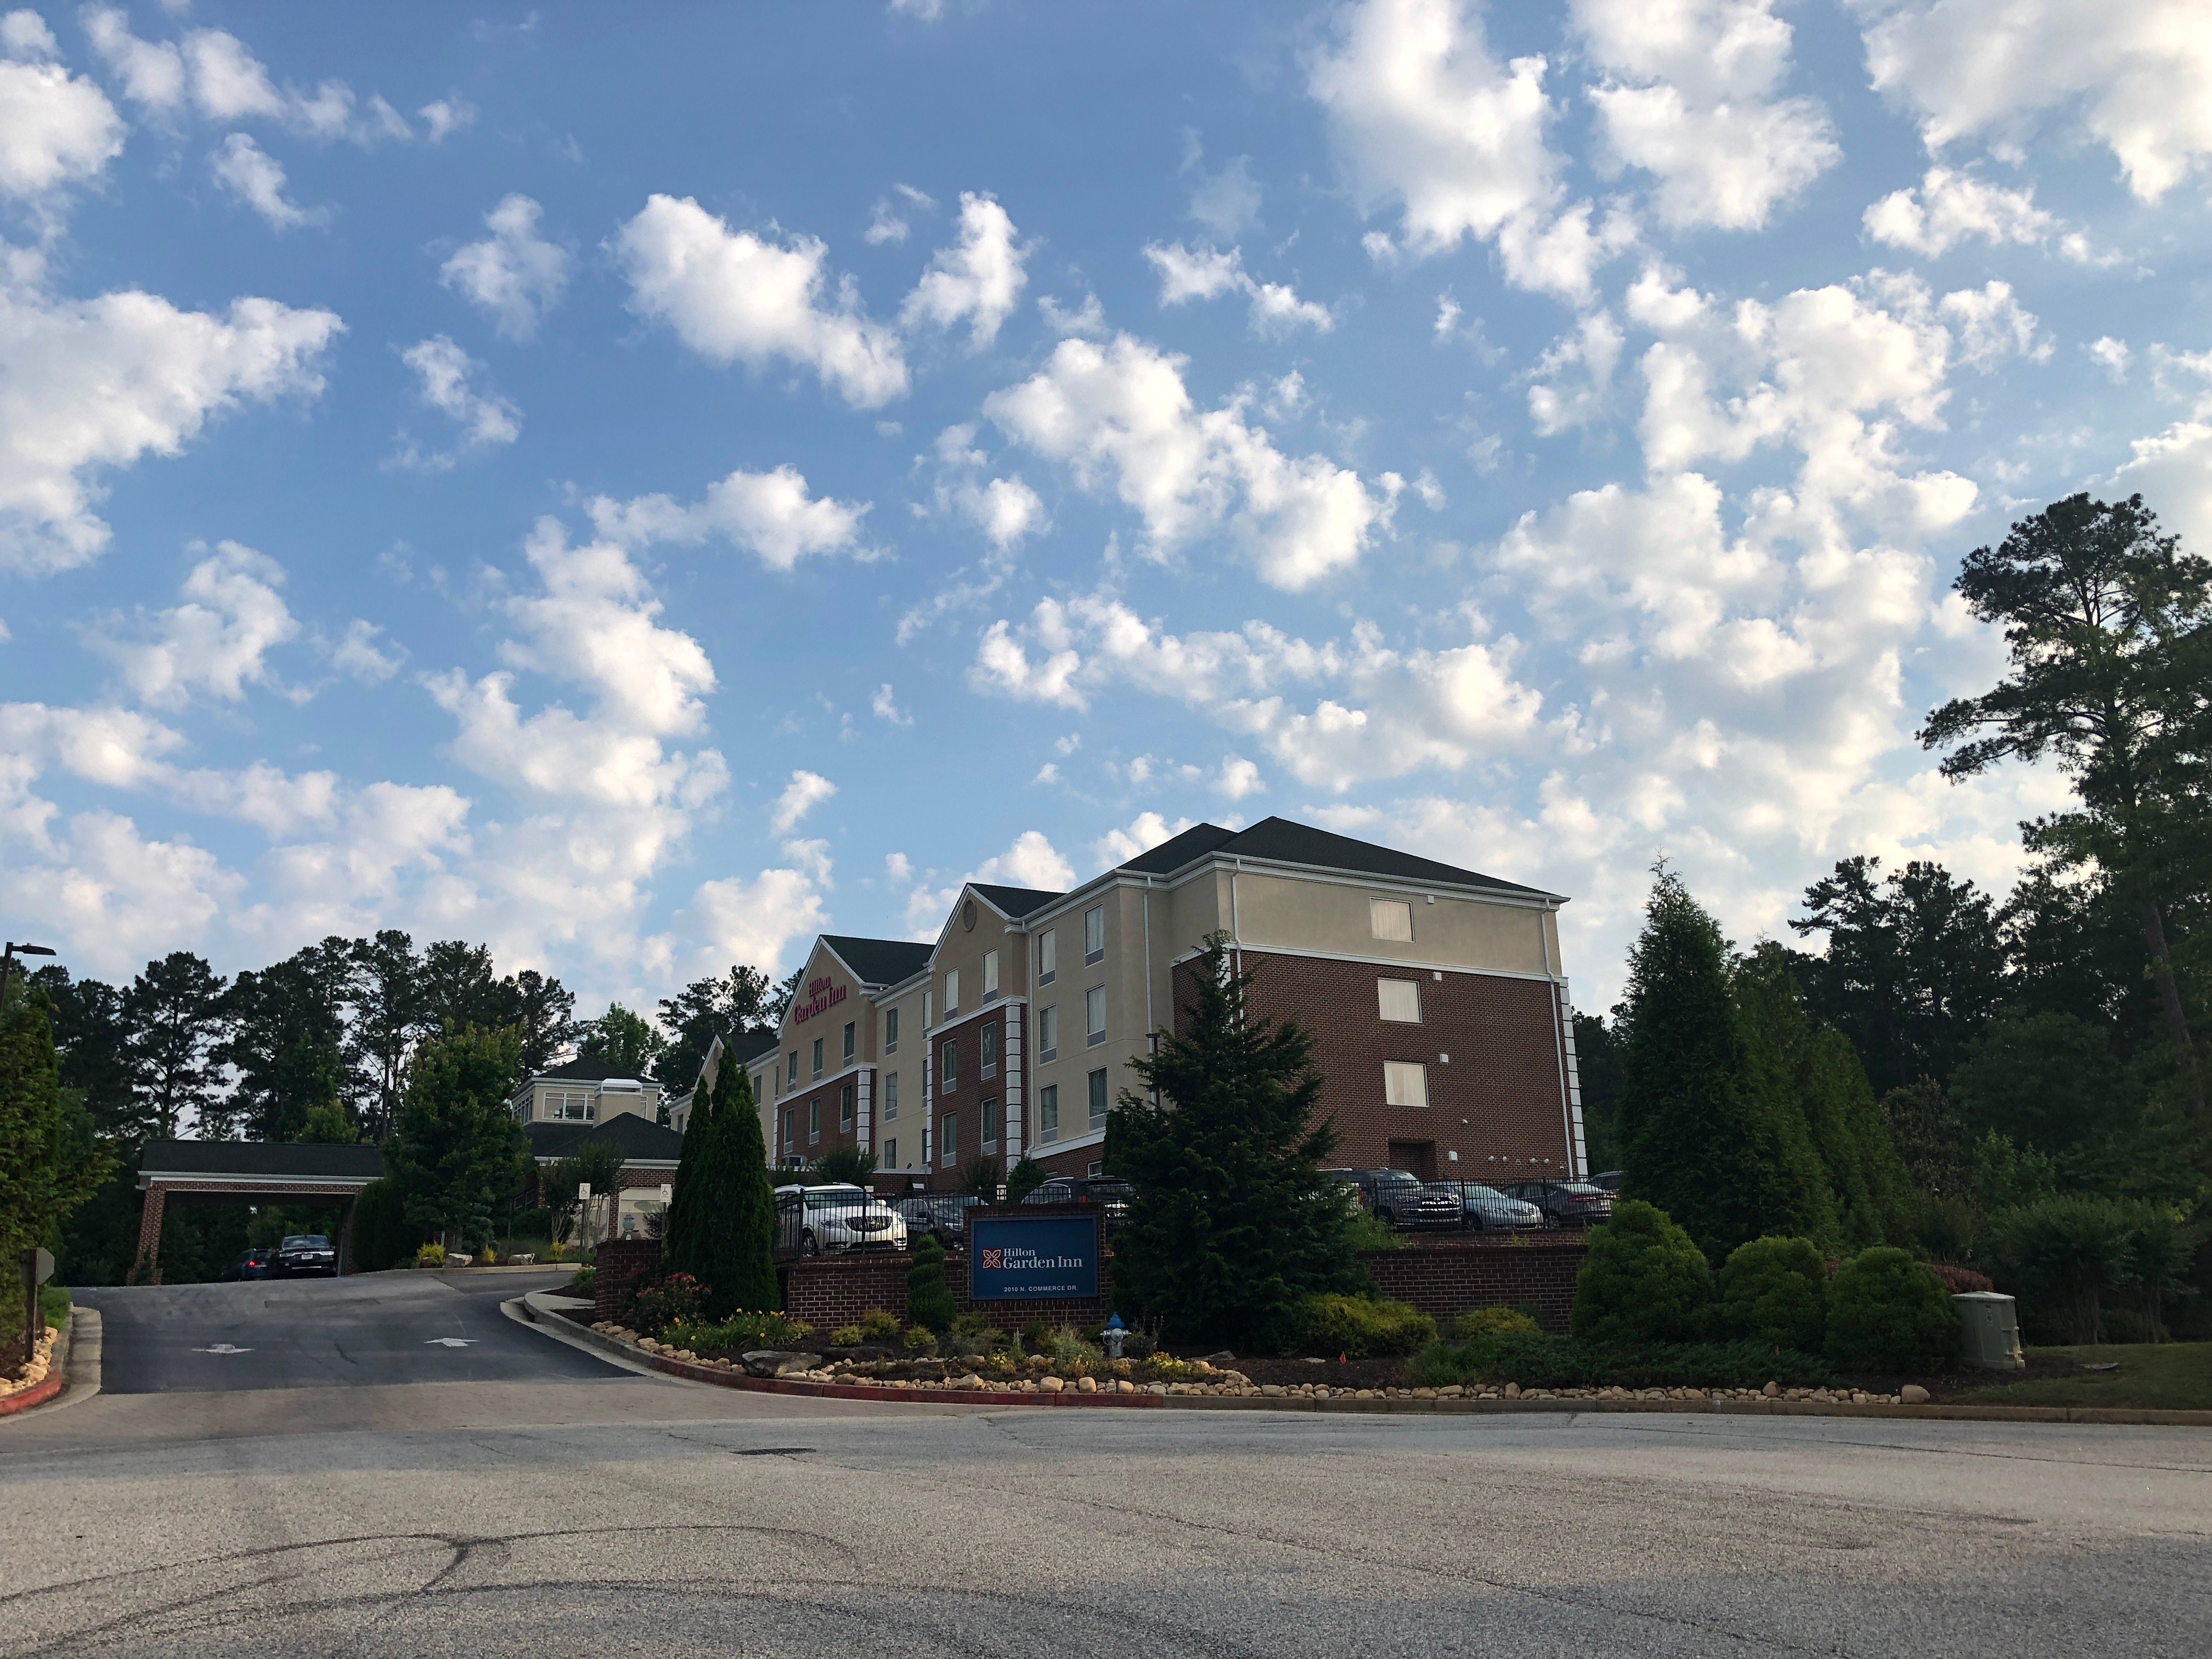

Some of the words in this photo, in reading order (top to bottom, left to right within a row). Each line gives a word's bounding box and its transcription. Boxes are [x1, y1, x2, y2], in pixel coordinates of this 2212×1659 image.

[794, 996, 827, 1025] Garden
[828, 985, 846, 1007] Inn
[1003, 1256, 1055, 1269] Garden
[1057, 1256, 1083, 1268] Inn
